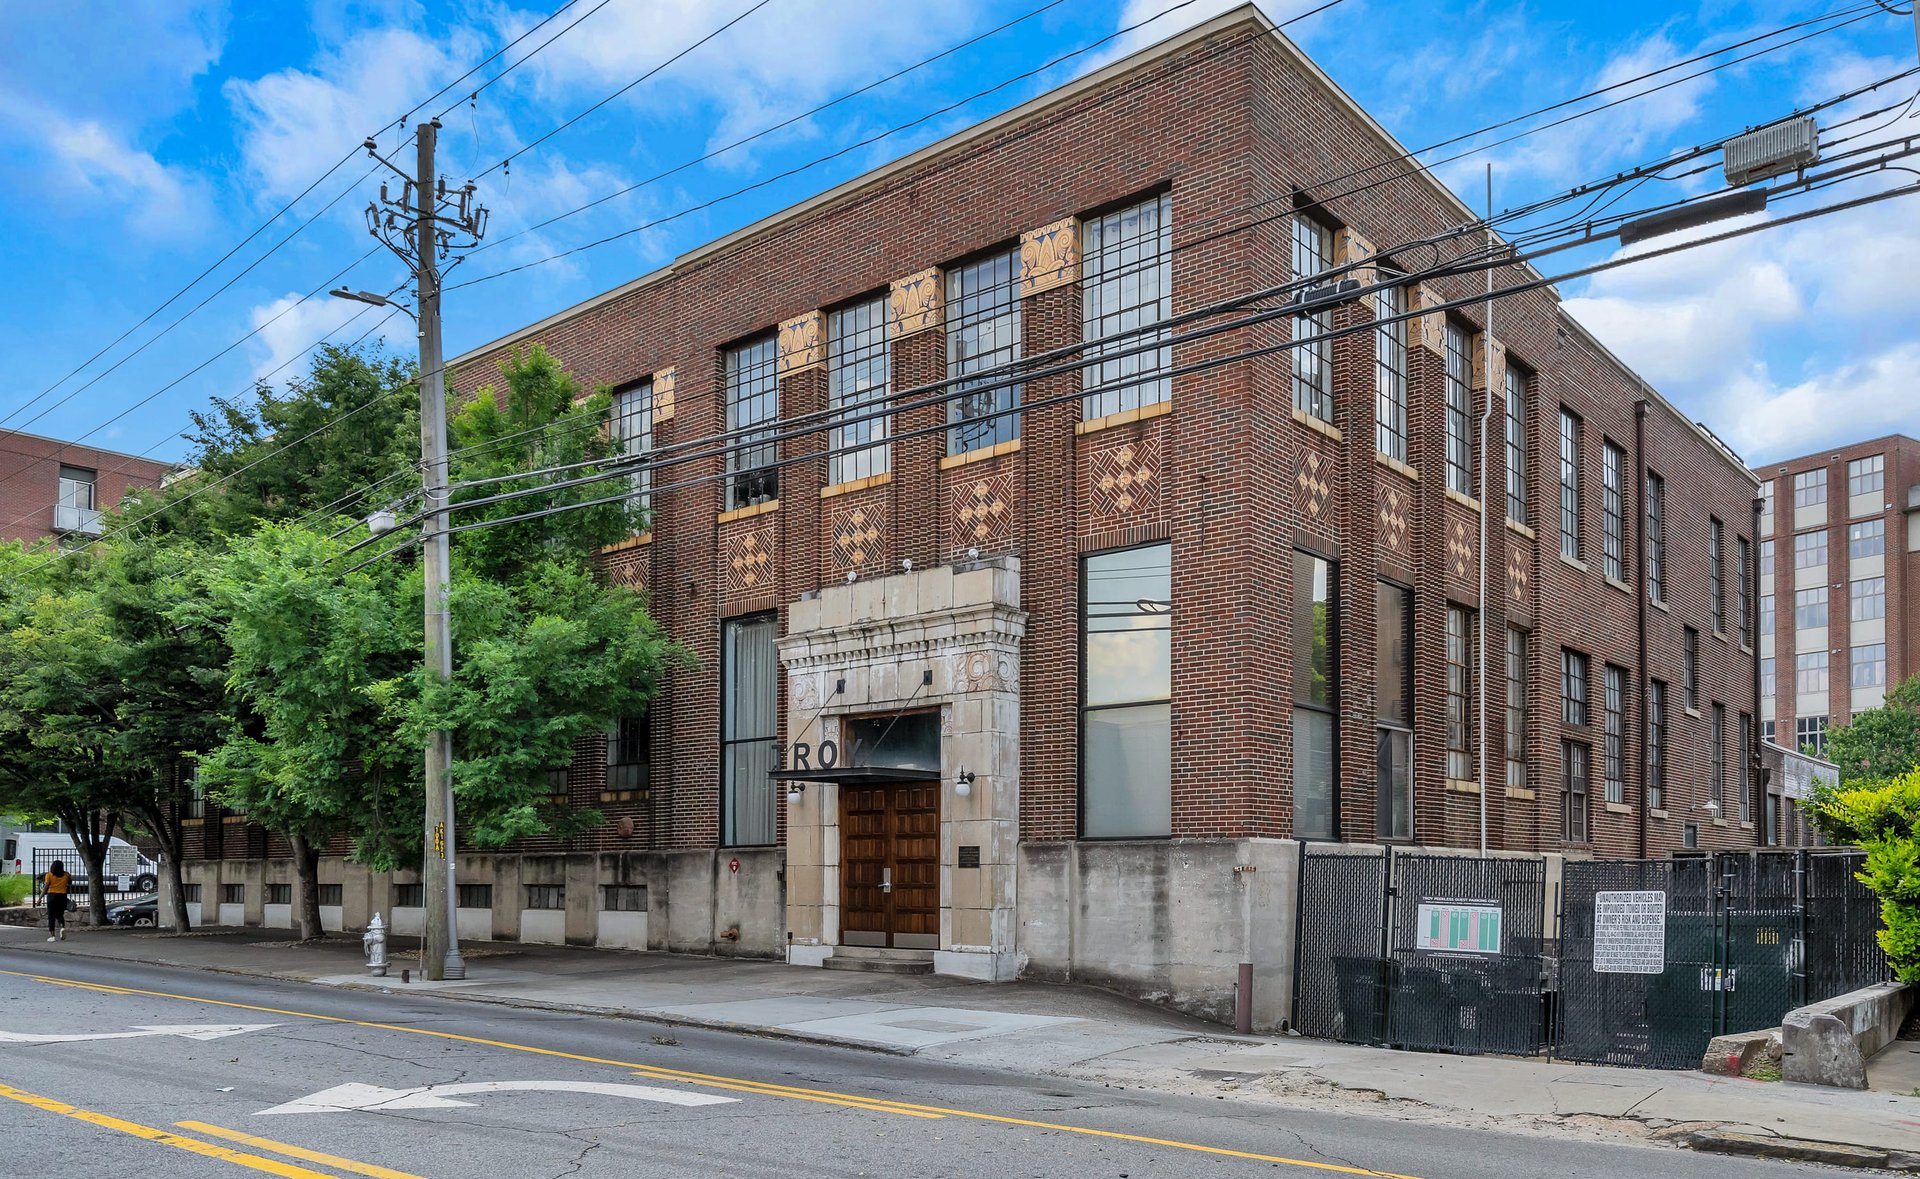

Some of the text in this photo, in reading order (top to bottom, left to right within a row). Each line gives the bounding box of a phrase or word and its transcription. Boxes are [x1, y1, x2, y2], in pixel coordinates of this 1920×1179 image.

[1596, 903, 1602, 913] BE
[1596, 914, 1602, 924] AT
[1622, 914, 1632, 924] RISK
[1632, 914, 1641, 924] AND
